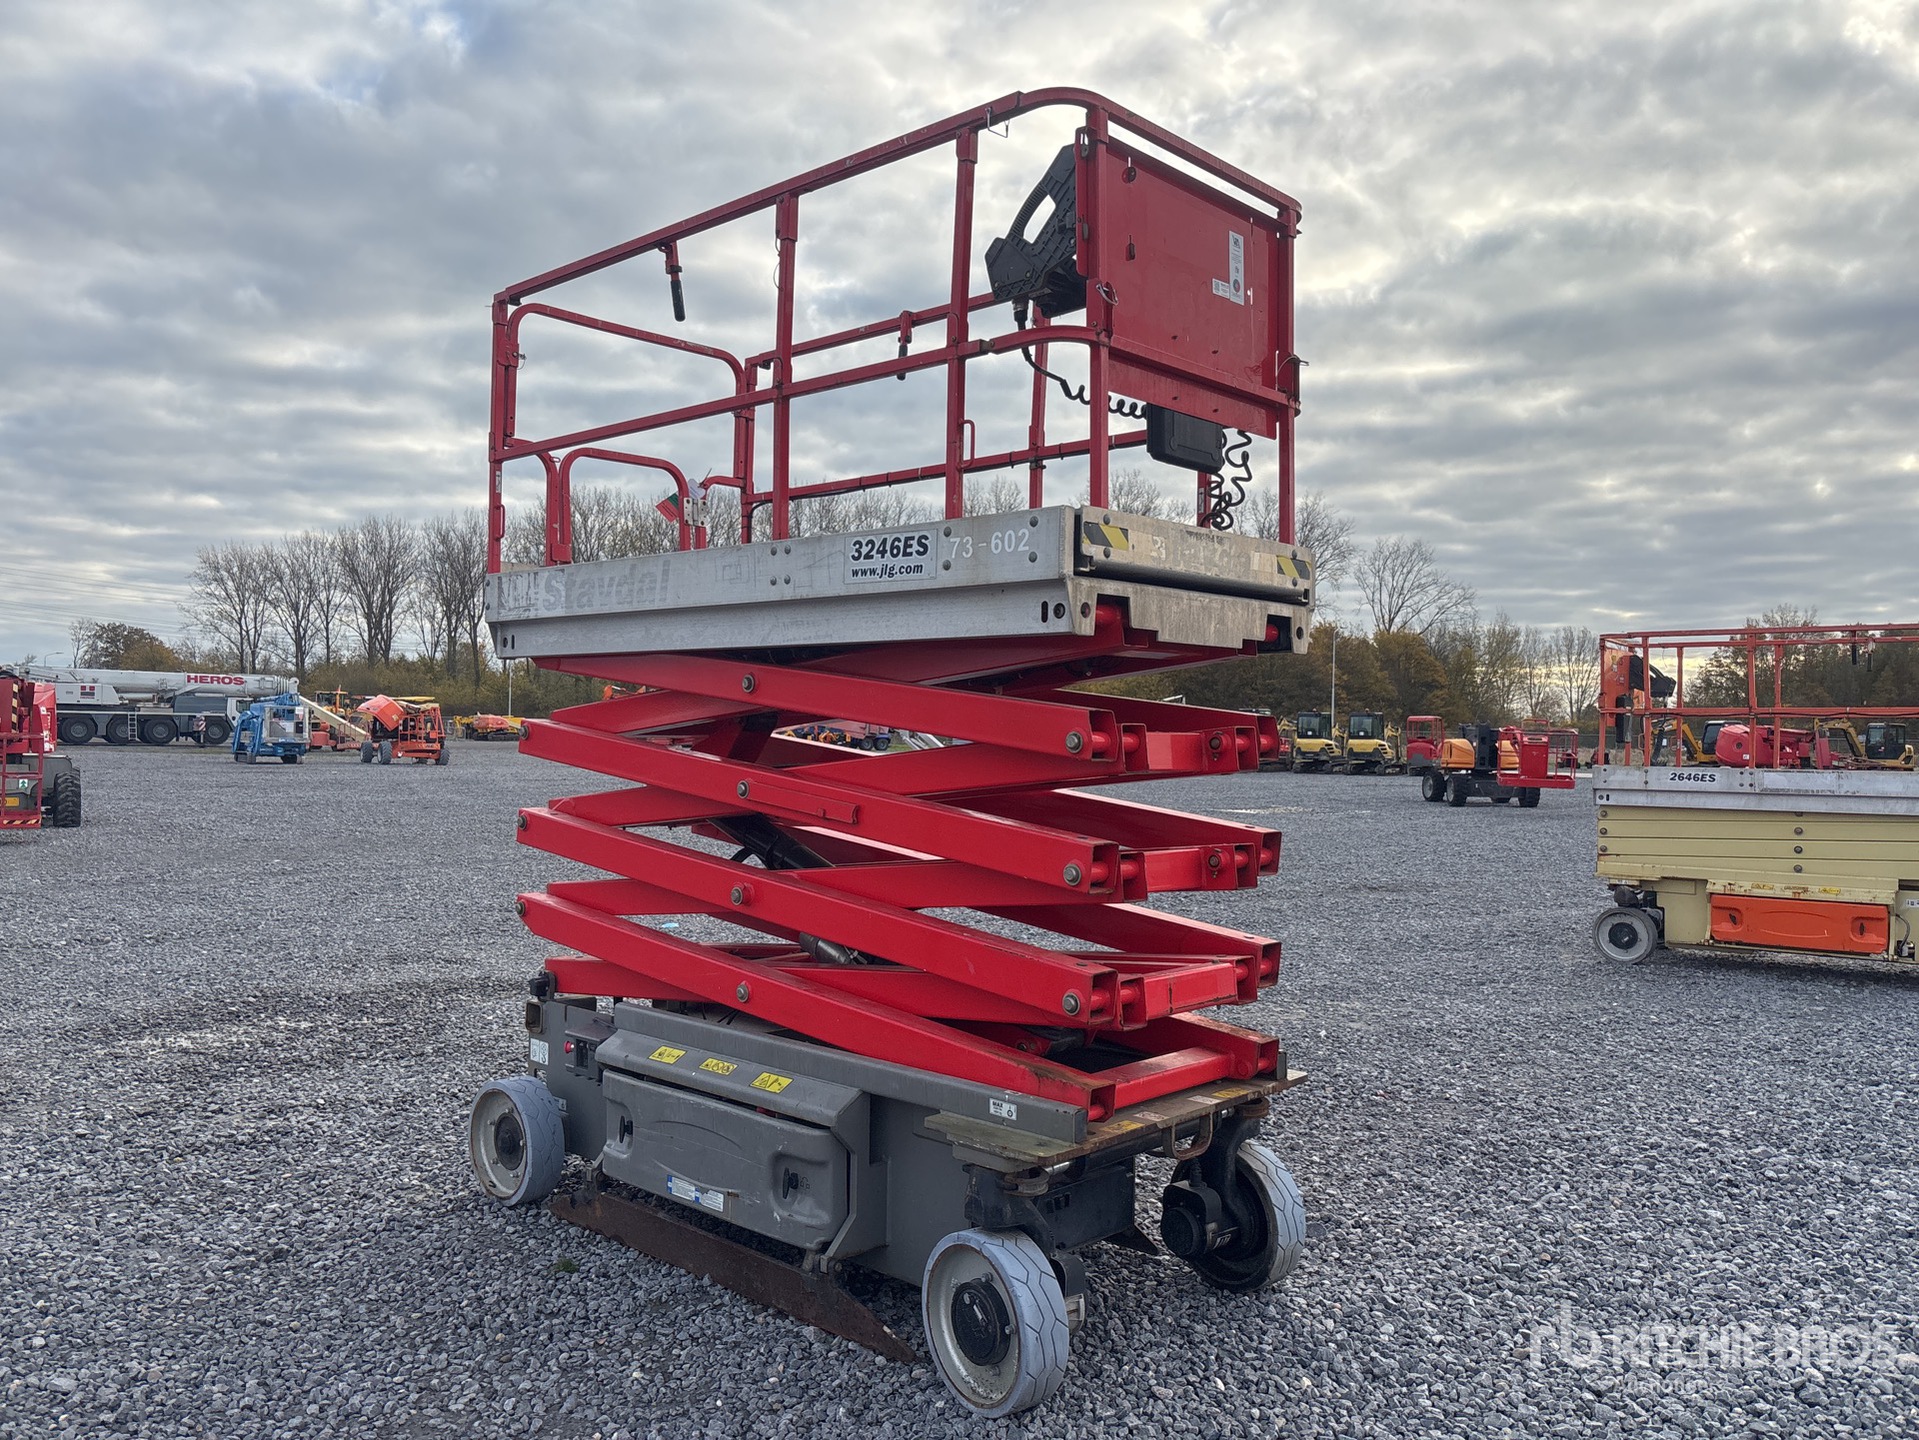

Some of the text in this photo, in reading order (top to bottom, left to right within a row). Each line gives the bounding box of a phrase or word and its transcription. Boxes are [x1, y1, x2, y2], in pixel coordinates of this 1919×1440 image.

[850, 534, 930, 562] 3246ES
[950, 528, 1030, 560] 73-602
[851, 563, 924, 579] www.jlg.com
[186, 674, 245, 686] HEROS
[1669, 772, 1717, 783] 2646ES
